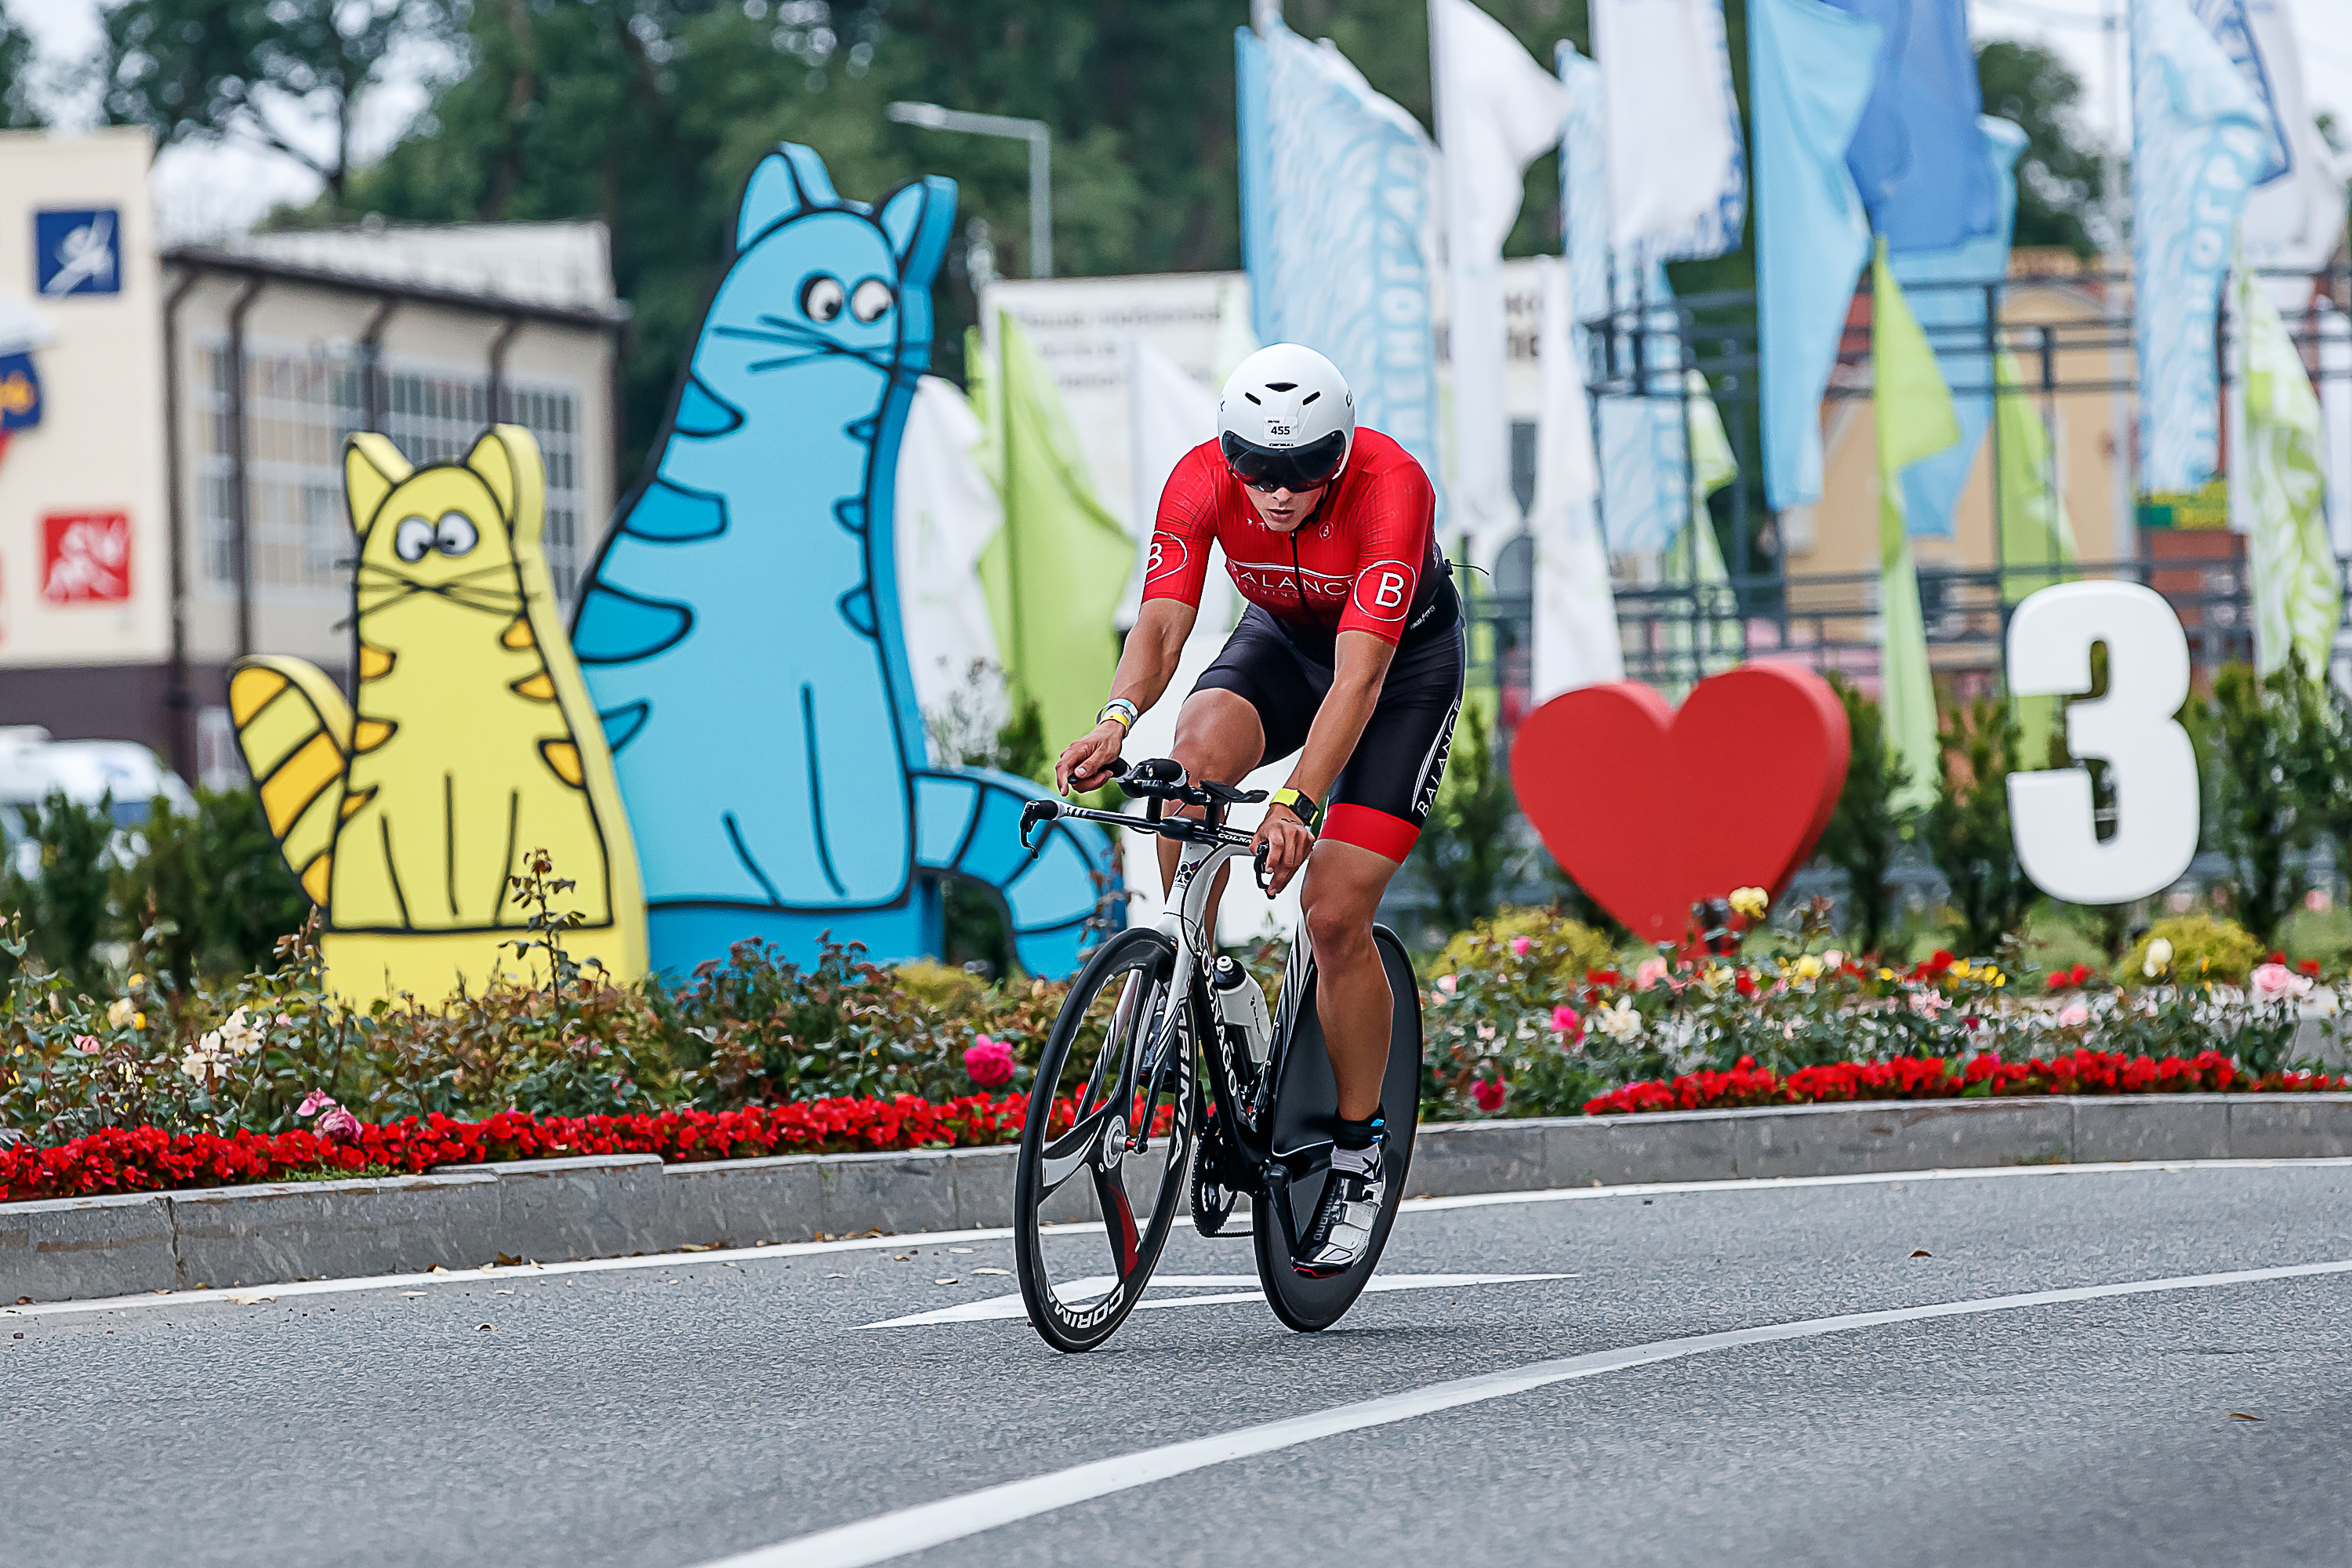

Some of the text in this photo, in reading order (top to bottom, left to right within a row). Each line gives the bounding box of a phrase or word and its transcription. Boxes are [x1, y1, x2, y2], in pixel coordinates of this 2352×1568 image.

[1375, 572, 1404, 608] B
[1218, 833, 1253, 844] COLNA
[1046, 1278, 1124, 1329] CORIMA
